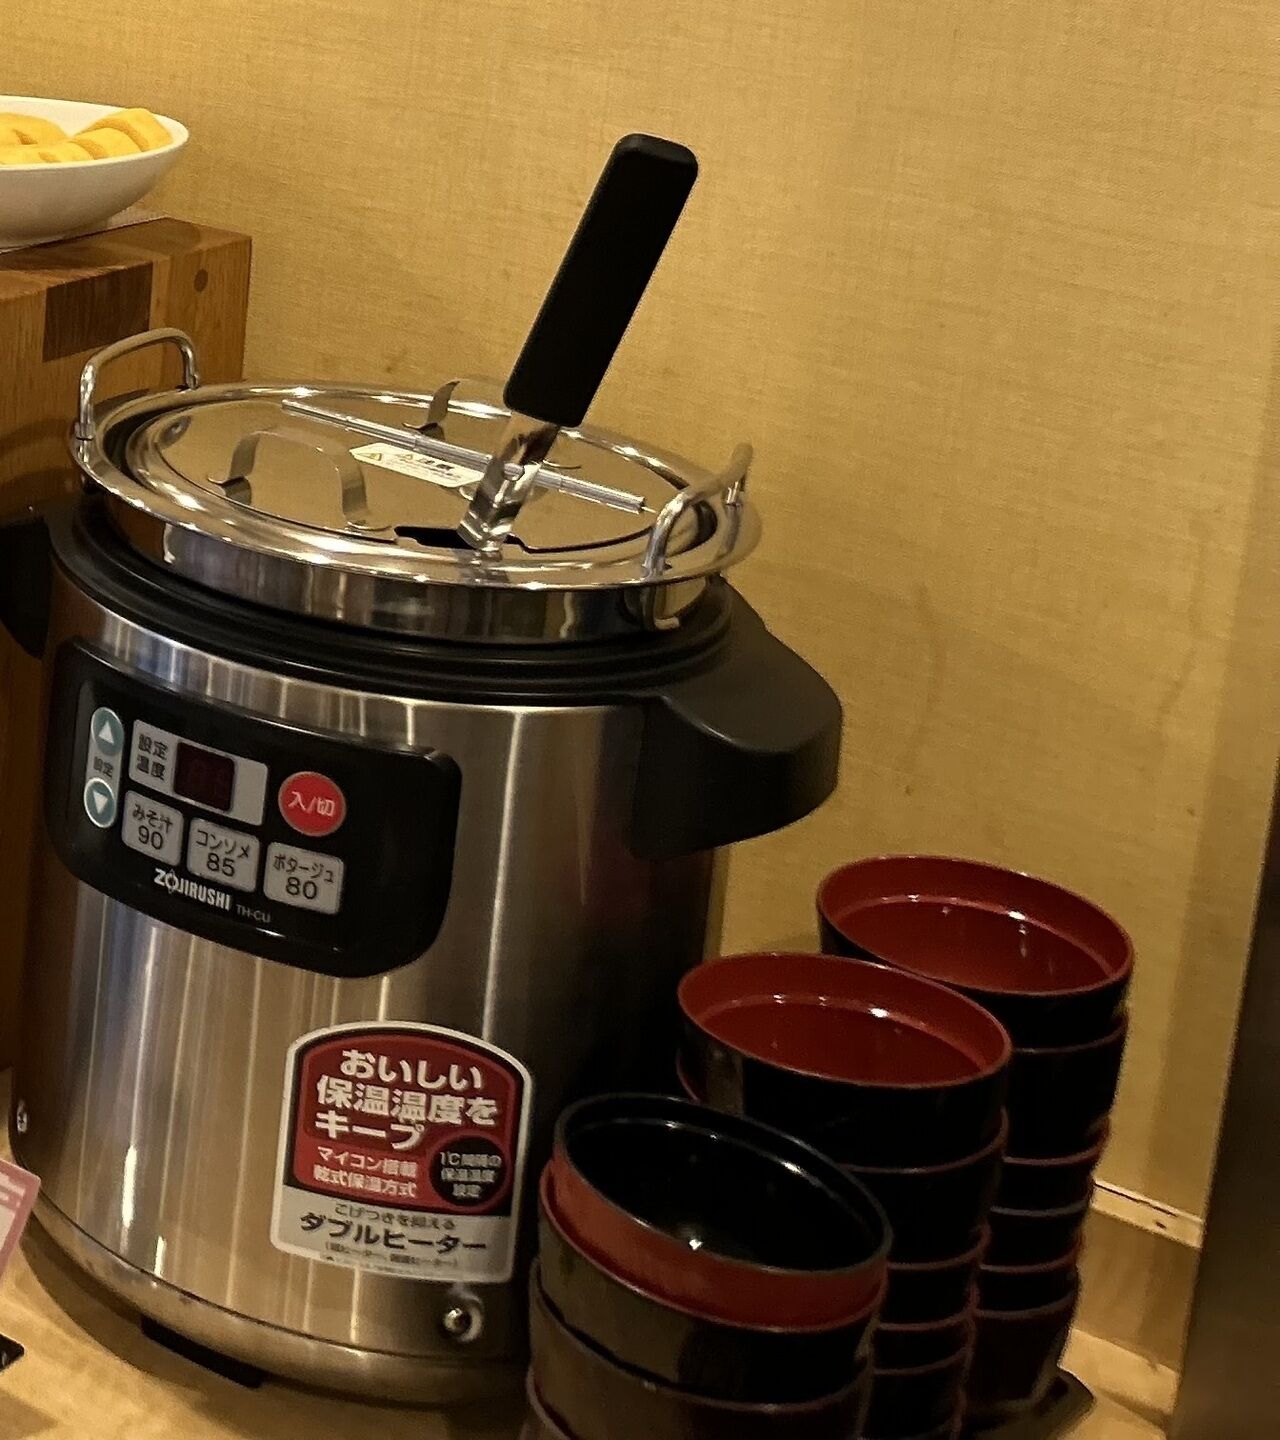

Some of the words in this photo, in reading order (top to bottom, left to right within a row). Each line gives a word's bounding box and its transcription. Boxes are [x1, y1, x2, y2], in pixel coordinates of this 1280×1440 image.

[138, 733, 168, 761] 設定
[132, 803, 173, 834] みそ汁
[288, 791, 336, 818] 入/切
[138, 825, 163, 850] 90
[196, 829, 250, 859] コンソメ
[206, 852, 235, 878] 85
[273, 854, 334, 884] ポタージュ
[153, 867, 232, 911] ZOJIRUSHI
[285, 876, 318, 900] 80
[339, 1048, 483, 1090] おいしい
[316, 1074, 498, 1127] 保温温度を
[315, 1109, 425, 1151] キープ
[317, 1145, 418, 1180] マイコン搭載
[300, 1211, 487, 1254] ダブルヒーター
